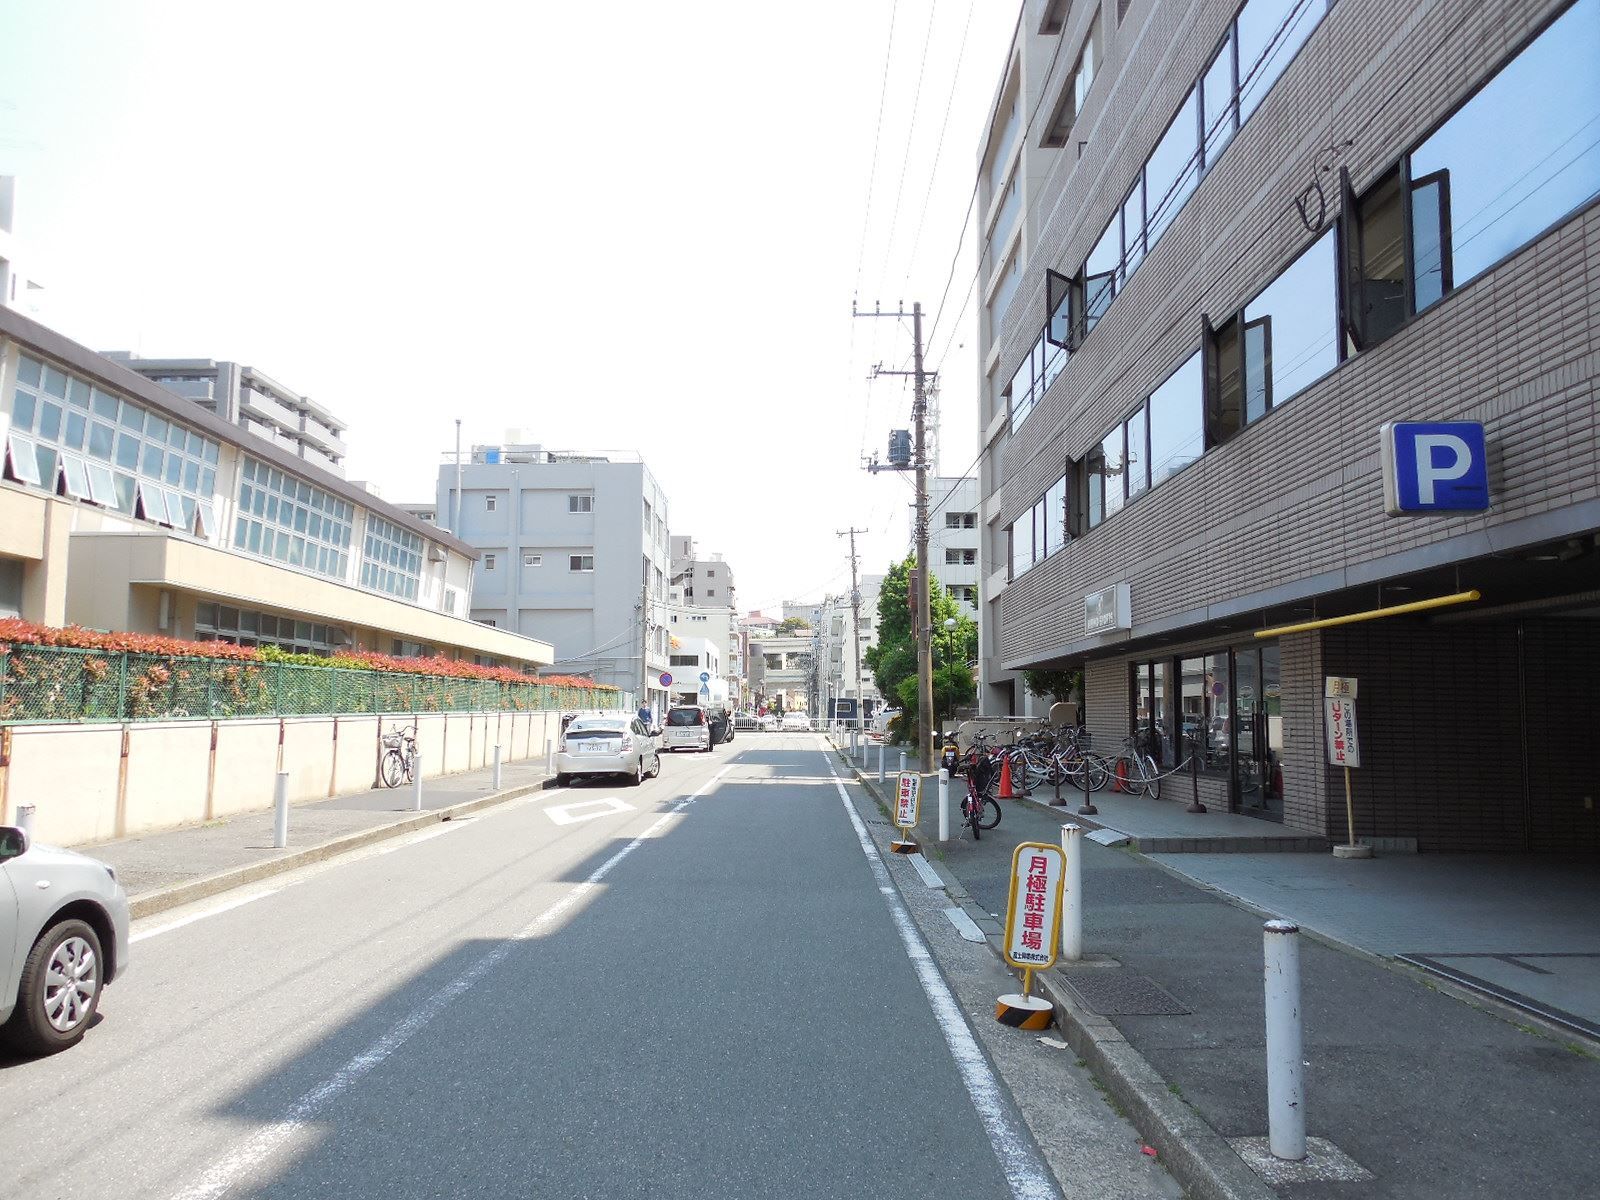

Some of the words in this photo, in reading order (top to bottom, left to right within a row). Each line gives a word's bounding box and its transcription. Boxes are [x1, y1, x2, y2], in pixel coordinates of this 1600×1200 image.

[1414, 434, 1472, 504] P
[899, 778, 911, 818] 駐車禁止
[1021, 856, 1048, 951] 月極駐車場
